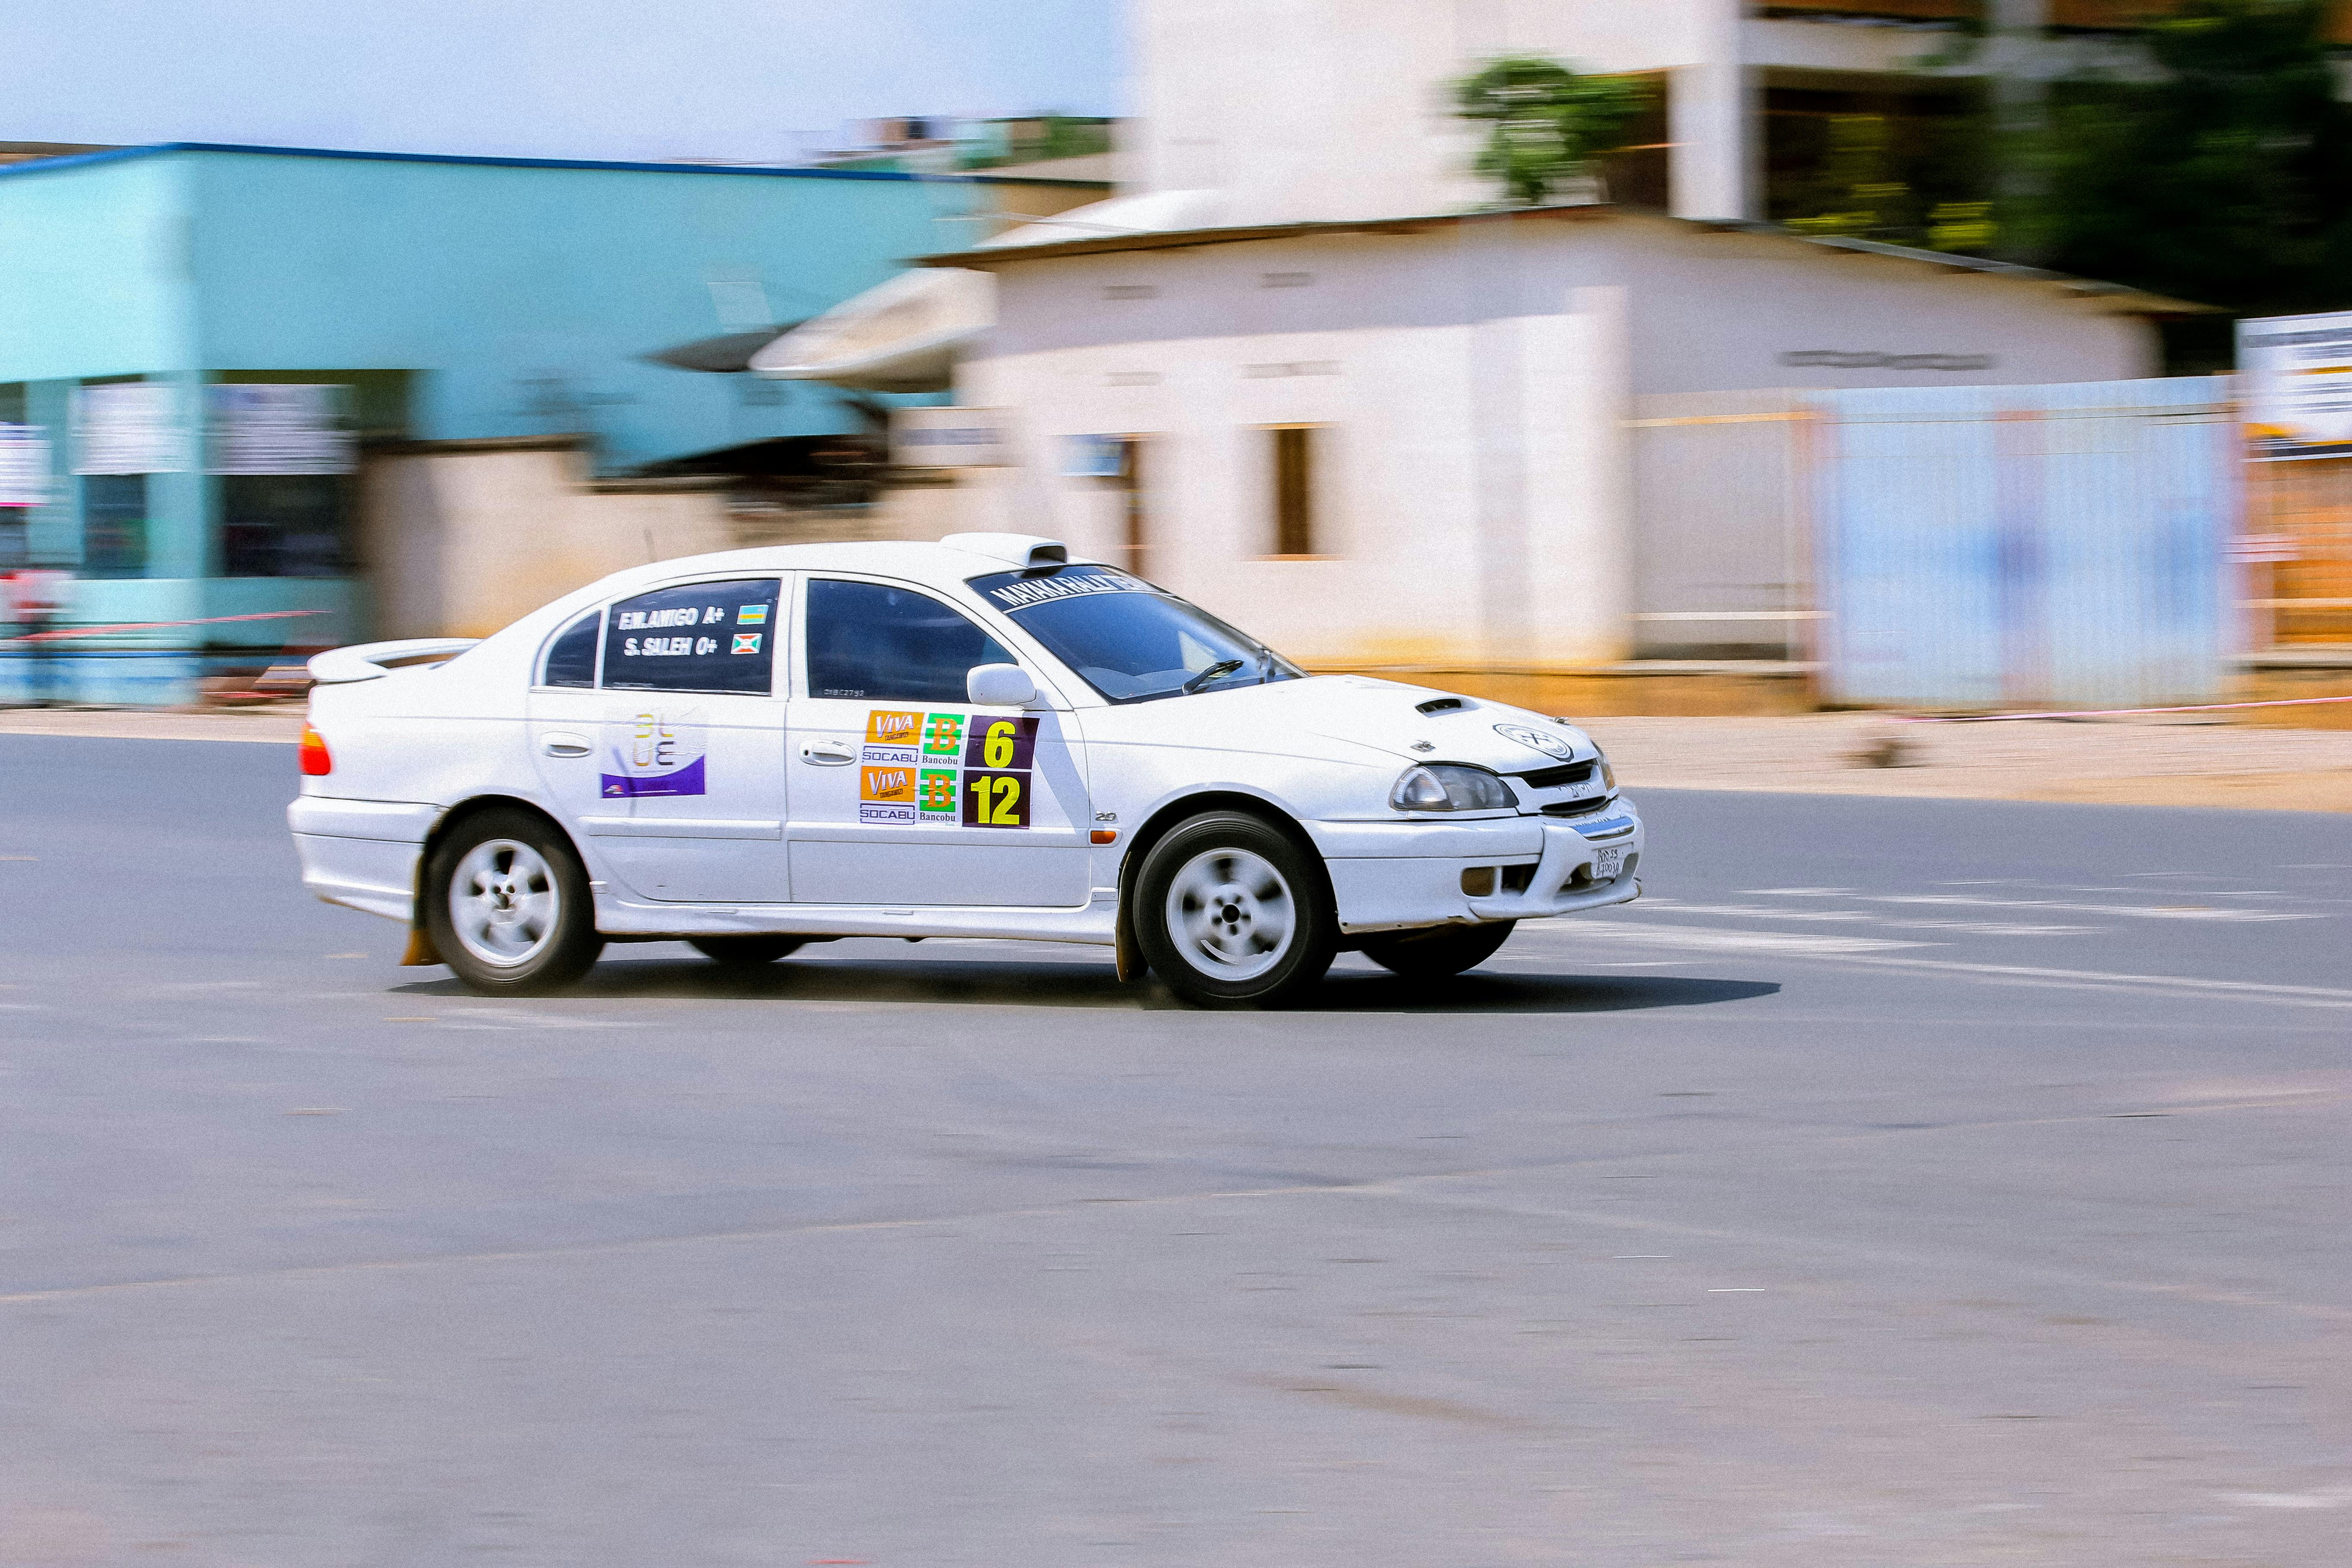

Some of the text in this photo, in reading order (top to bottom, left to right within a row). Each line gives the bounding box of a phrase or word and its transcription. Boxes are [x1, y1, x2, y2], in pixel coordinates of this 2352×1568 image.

[989, 578, 1076, 606] MAYAKA
[1054, 574, 1119, 595] RALLY
[701, 606, 725, 625] A+
[695, 636, 718, 655] O+
[876, 714, 914, 738] VIVA
[929, 717, 958, 751] B
[984, 721, 1015, 768] 6
[862, 752, 919, 763] SOCABU
[922, 755, 958, 765] Bancobu
[867, 770, 908, 795] VIVA
[925, 774, 951, 808] B
[971, 776, 1020, 825] 12
[860, 809, 916, 820] SOCABU
[919, 812, 956, 822] Bancobu
